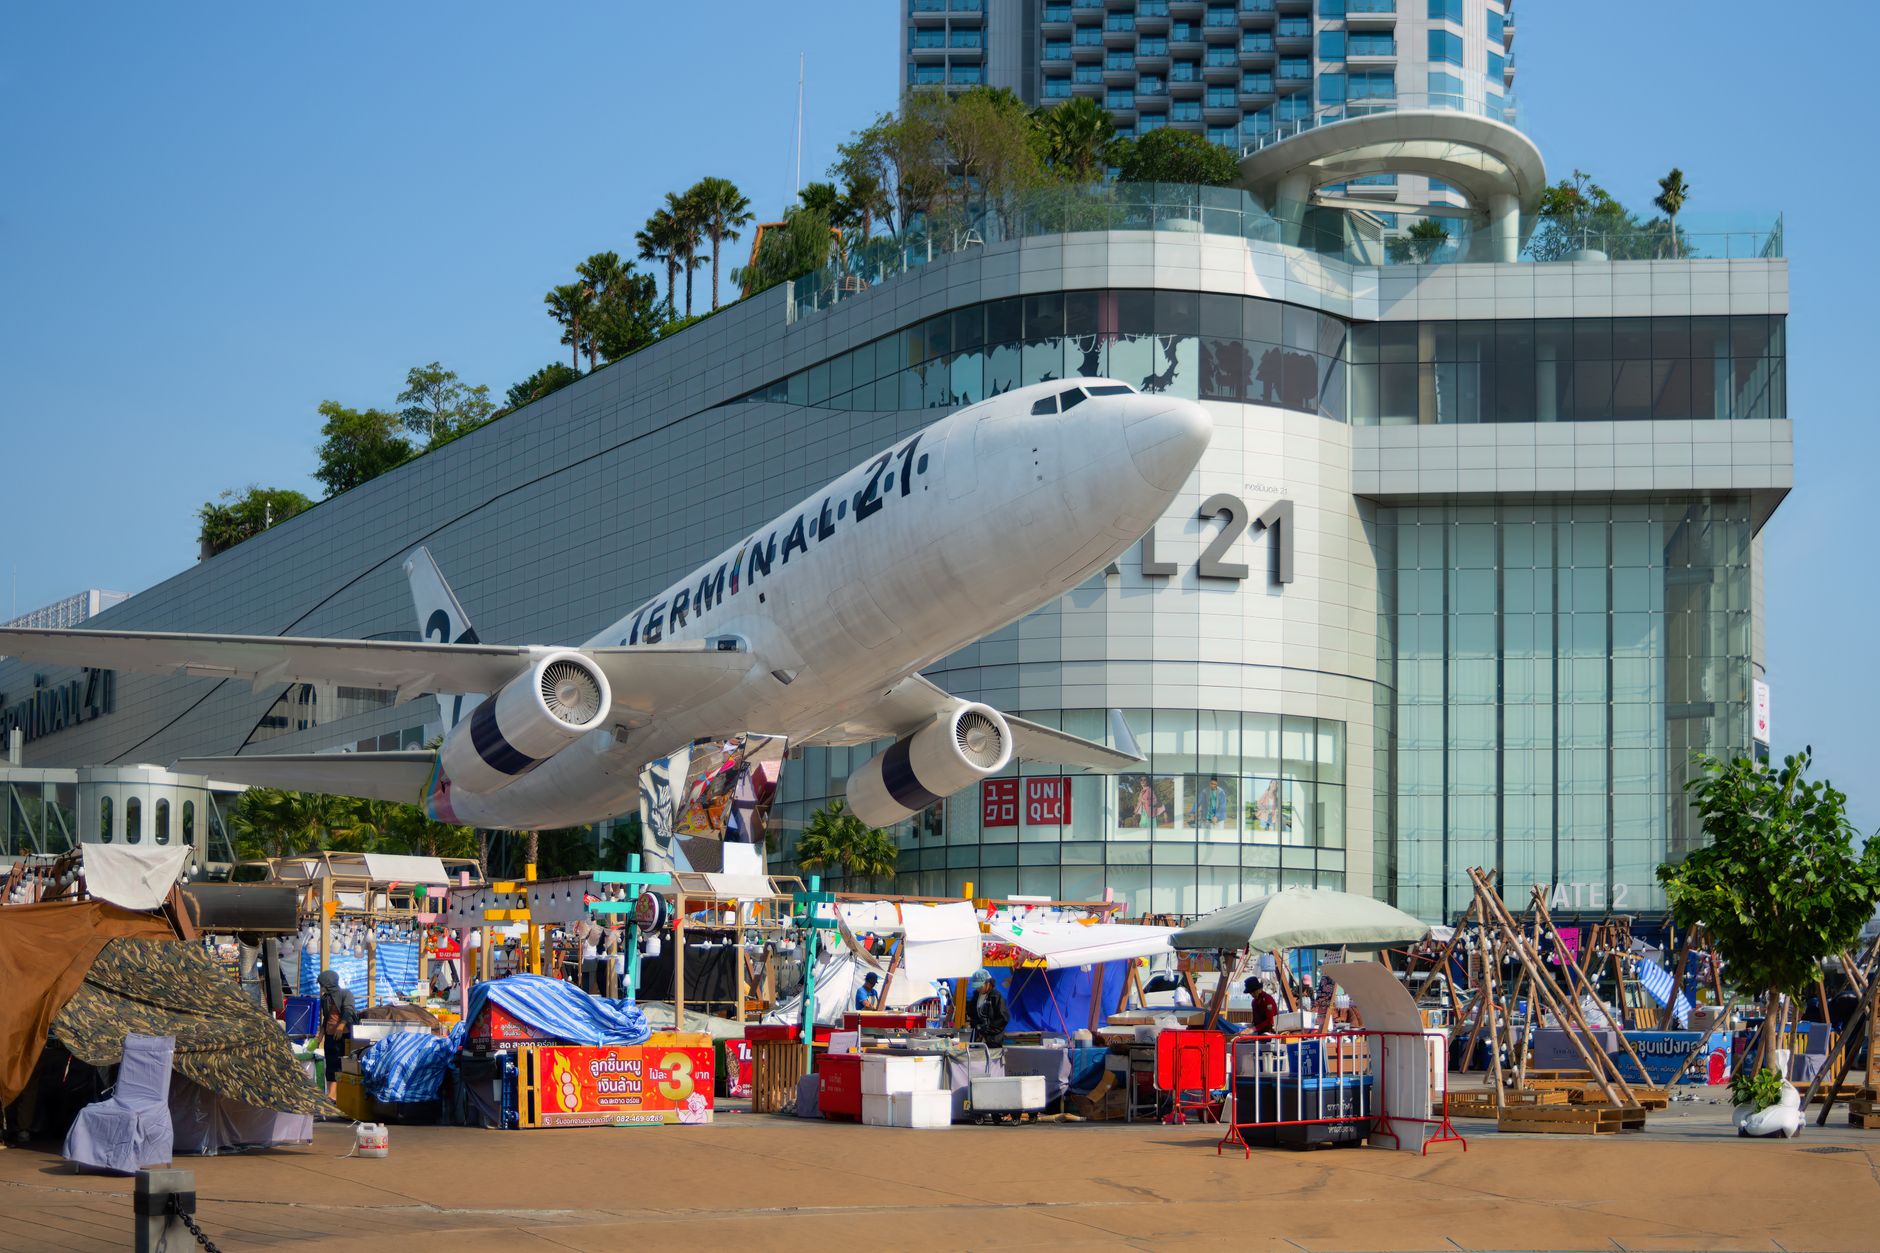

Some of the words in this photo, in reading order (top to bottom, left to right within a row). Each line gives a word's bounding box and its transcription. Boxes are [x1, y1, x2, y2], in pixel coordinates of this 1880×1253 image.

[629, 497, 836, 645] TERMINAL
[855, 432, 925, 523] 21
[1199, 493, 1294, 584] 21
[1612, 883, 1628, 908] 2
[590, 1052, 641, 1077] ลูกชิ้นหมู
[649, 1067, 668, 1080] ไม้ละ
[658, 1051, 695, 1101] 3
[694, 1071, 710, 1080] บาท
[597, 1077, 641, 1093] เงินล้าน
